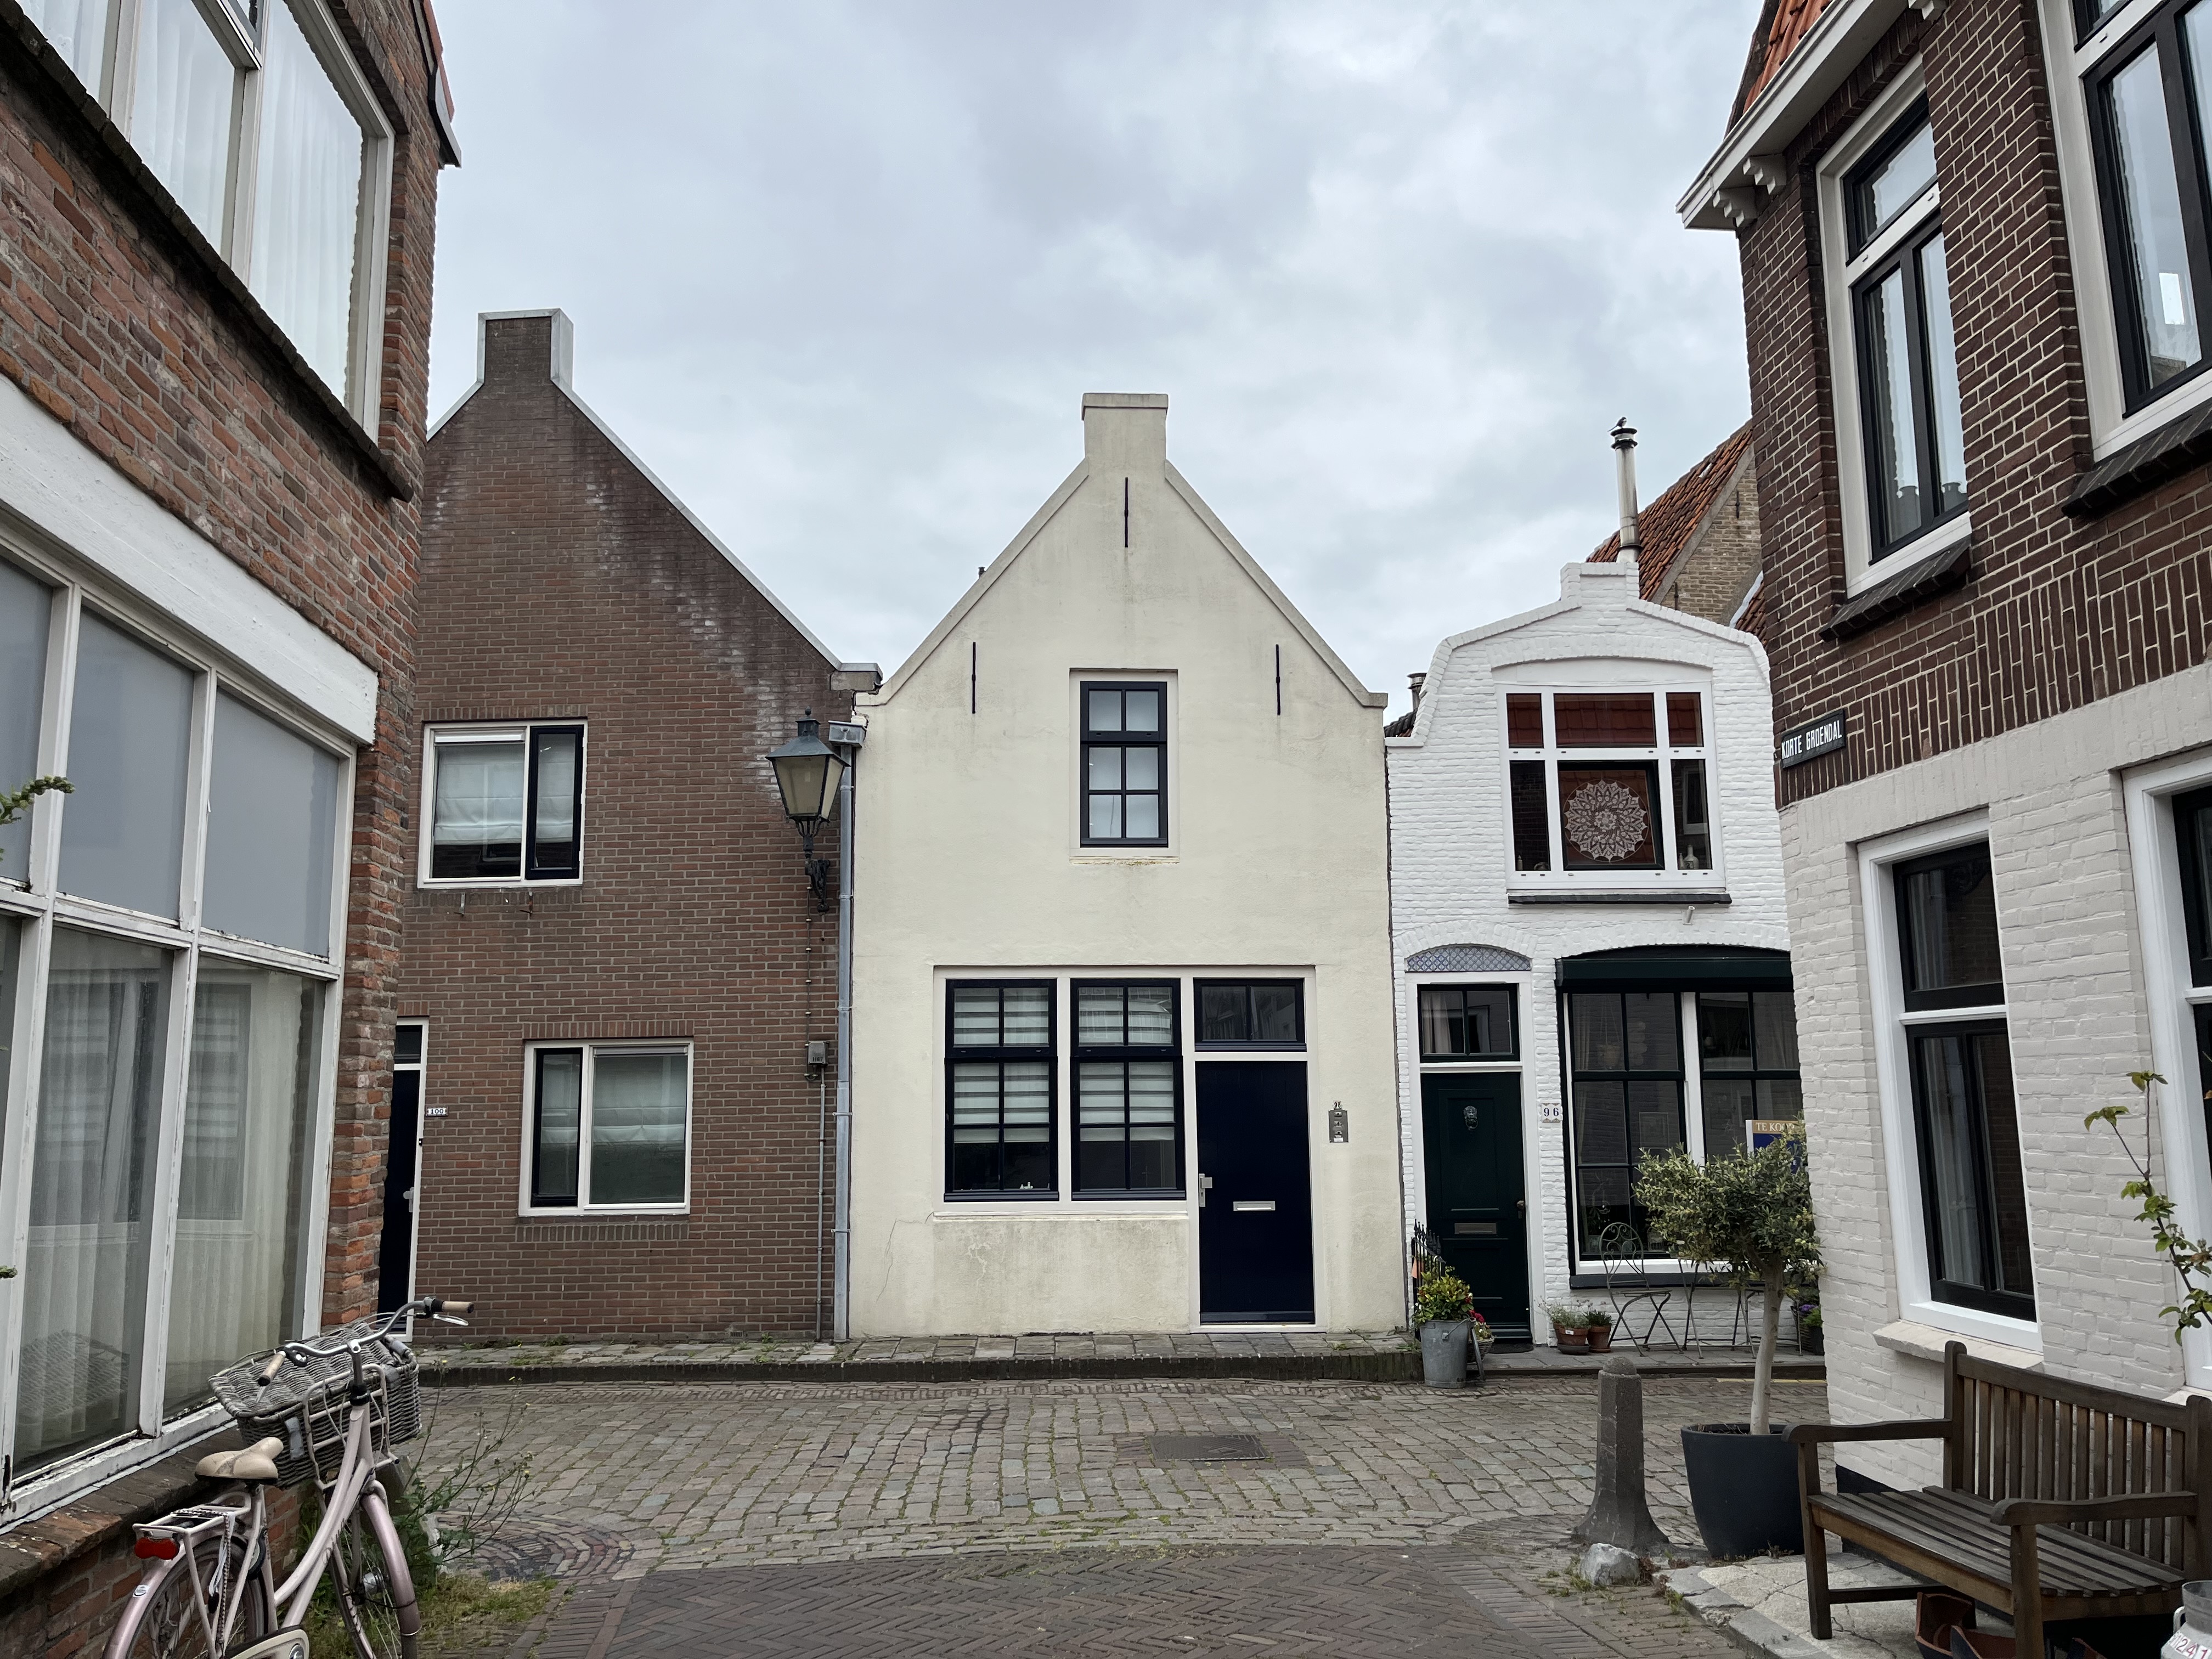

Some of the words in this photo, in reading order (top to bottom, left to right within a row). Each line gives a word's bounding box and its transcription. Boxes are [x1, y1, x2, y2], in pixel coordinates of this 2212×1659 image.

[1781, 735, 1802, 759] KORTE
[1806, 720, 1842, 751] GROENDAL
[1544, 1107, 1559, 1116] 96
[1756, 1122, 1768, 1131] TE
